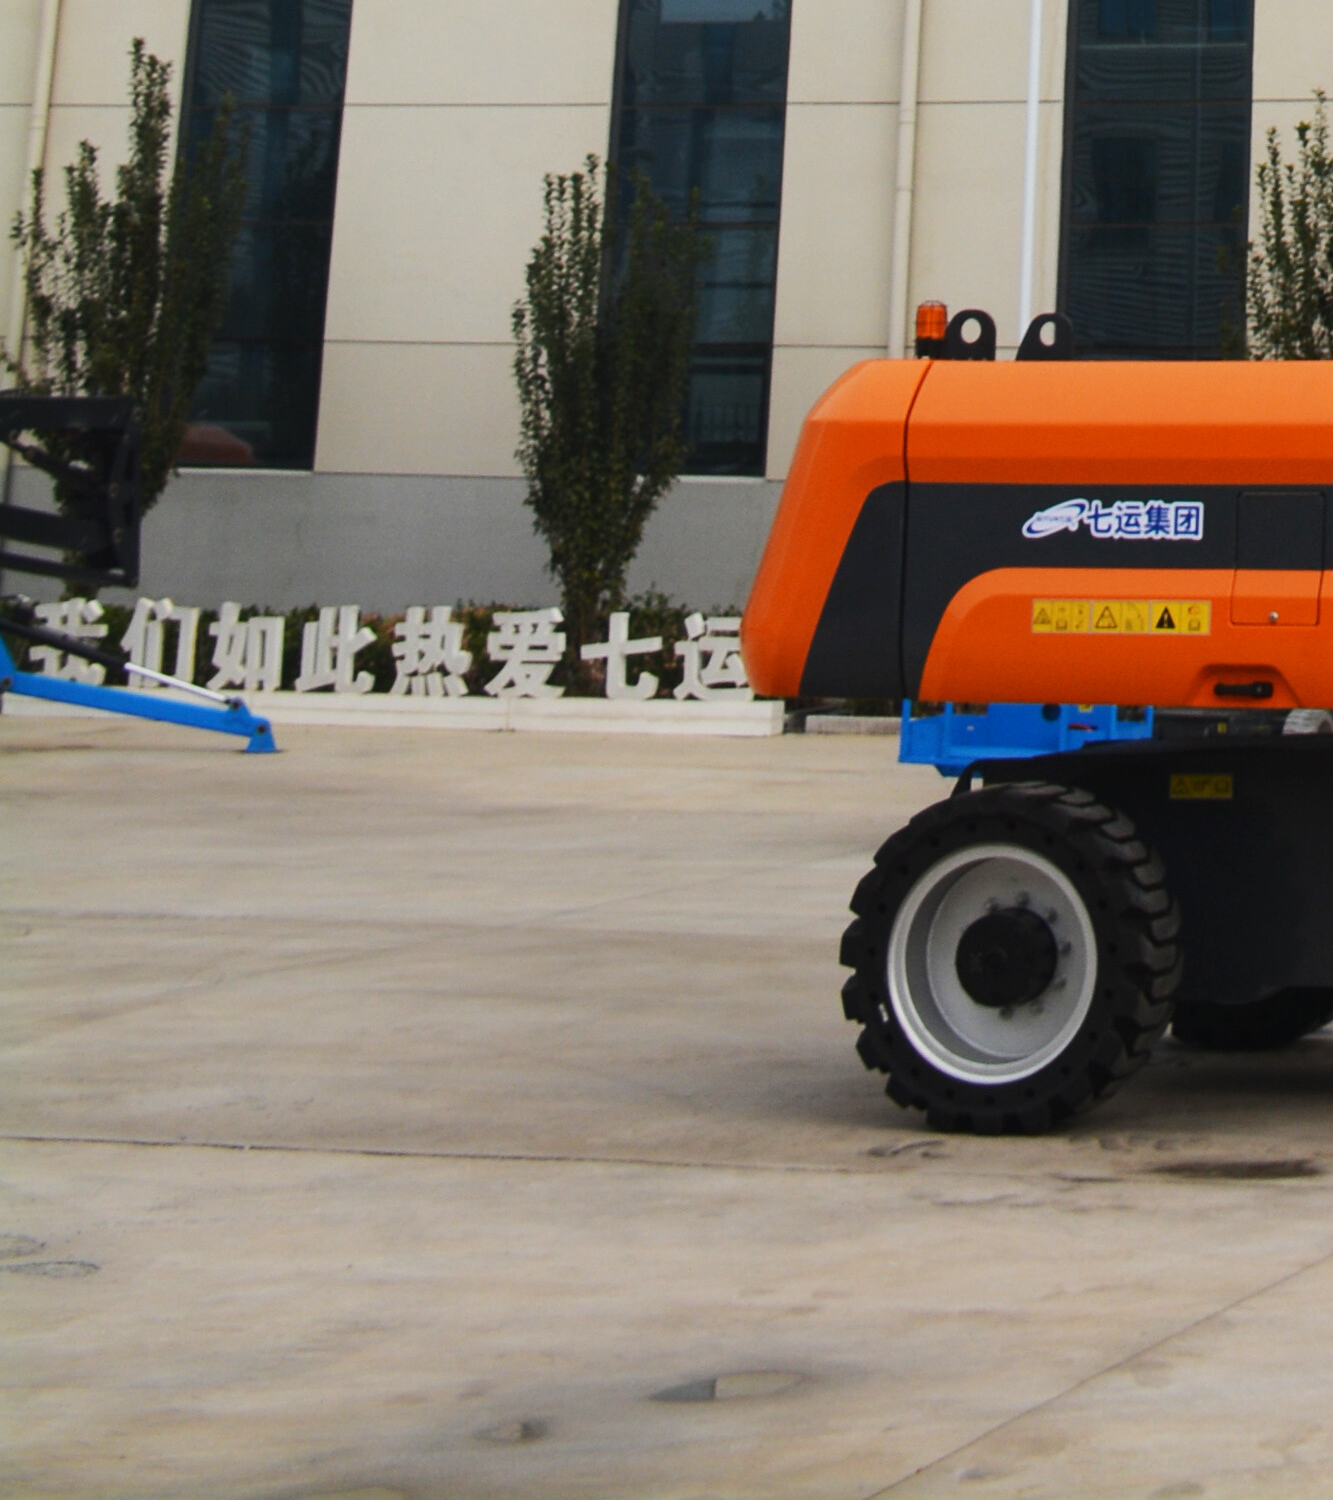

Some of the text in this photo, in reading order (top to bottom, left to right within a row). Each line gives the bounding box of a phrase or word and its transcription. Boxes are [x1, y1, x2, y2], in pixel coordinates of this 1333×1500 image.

[1087, 503, 1201, 537] 七运集团
[29, 596, 756, 701] 我们如此热爱七运
